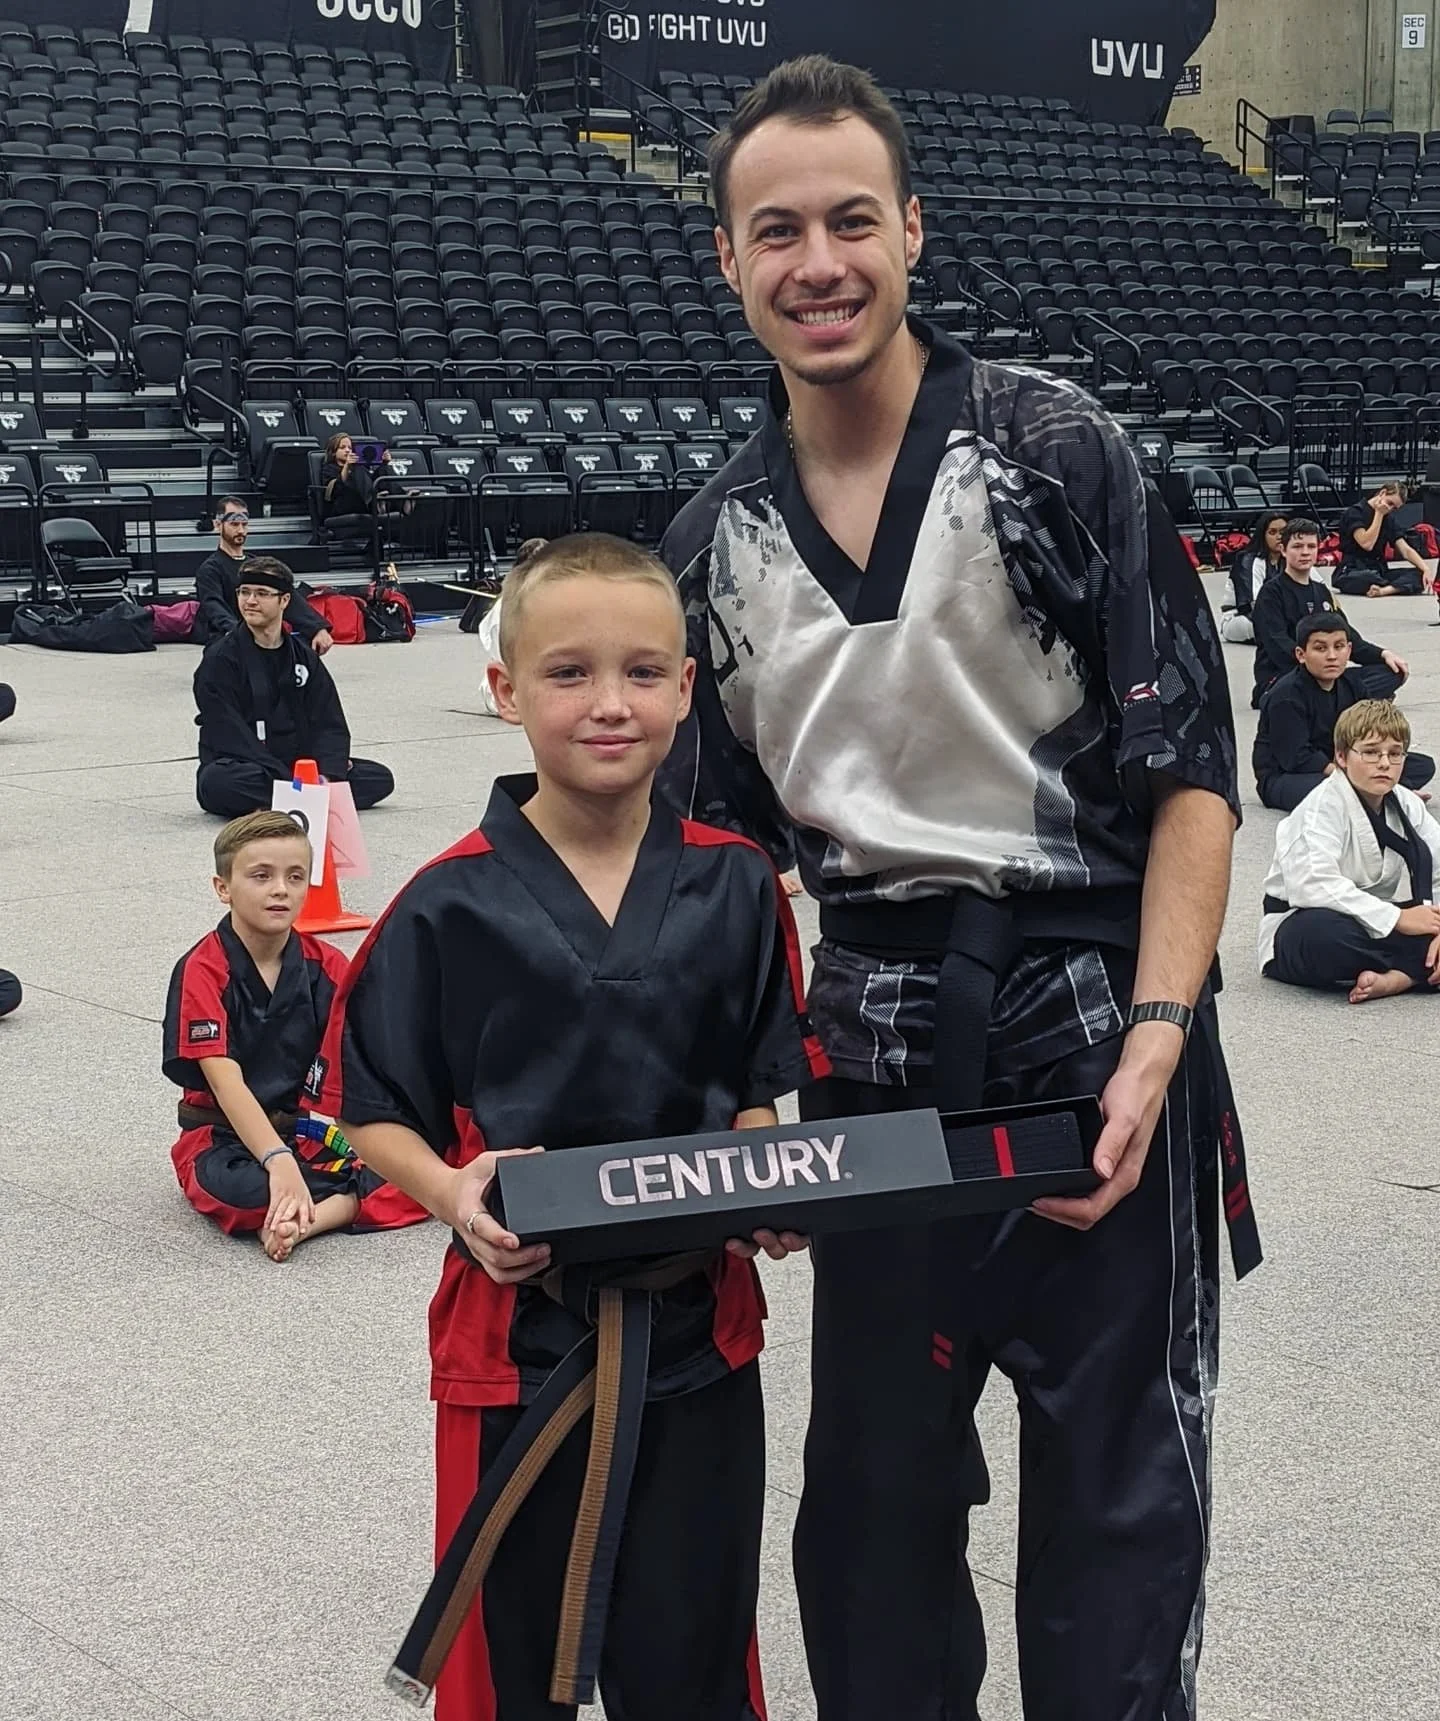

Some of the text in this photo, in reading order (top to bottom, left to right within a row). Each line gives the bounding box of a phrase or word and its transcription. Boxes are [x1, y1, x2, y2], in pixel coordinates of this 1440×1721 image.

[607, 13, 640, 41] GO
[717, 18, 767, 47] UVU
[1403, 17, 1425, 28] SEC
[1408, 30, 1418, 46] 9
[1091, 37, 1164, 79] UVU
[598, 1134, 847, 1206] CENTURY
